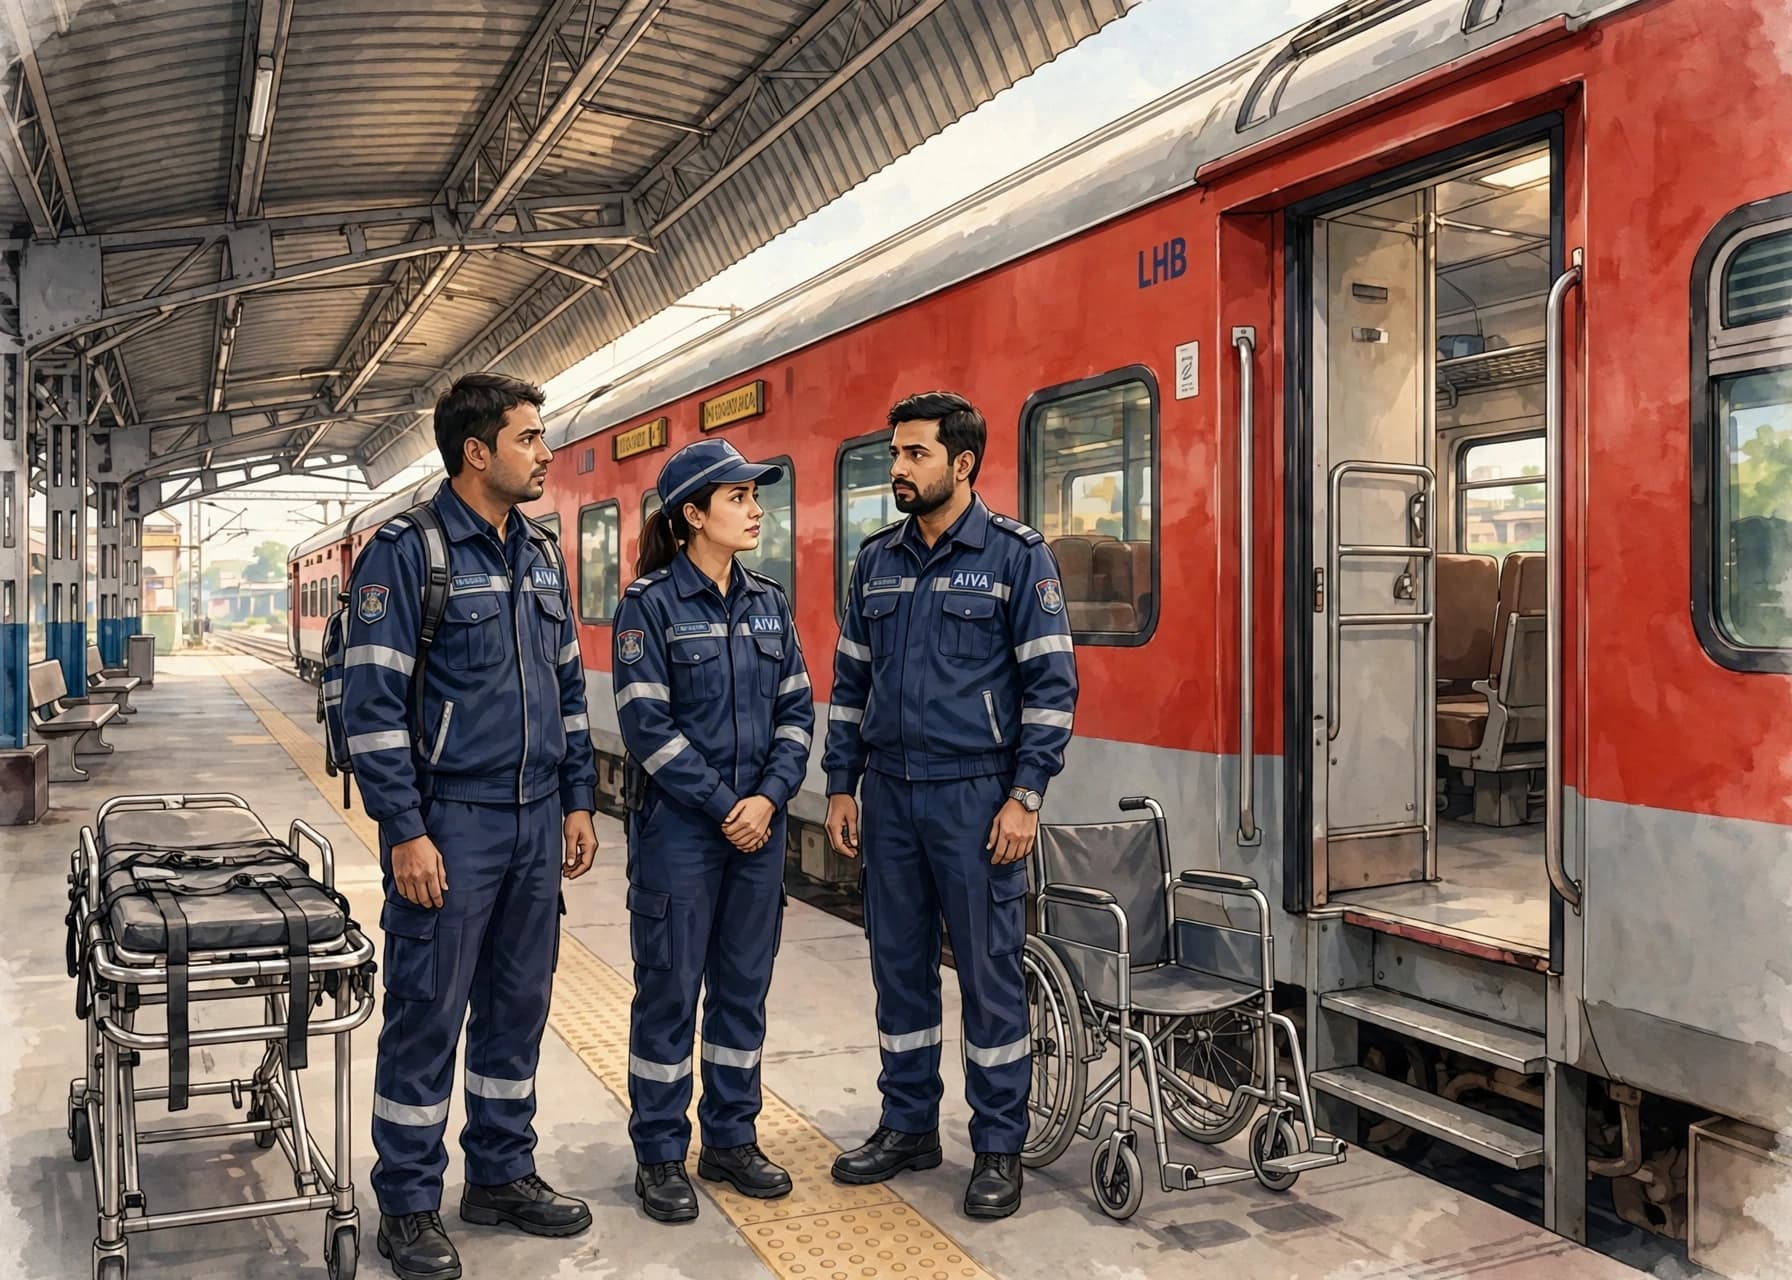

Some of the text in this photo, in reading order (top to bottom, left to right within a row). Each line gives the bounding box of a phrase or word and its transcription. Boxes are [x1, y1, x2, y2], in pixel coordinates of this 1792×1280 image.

[1138, 236, 1187, 289] LHB
[535, 570, 560, 586] AIVA
[953, 572, 990, 589] AIVA
[754, 618, 781, 632] AIVA
